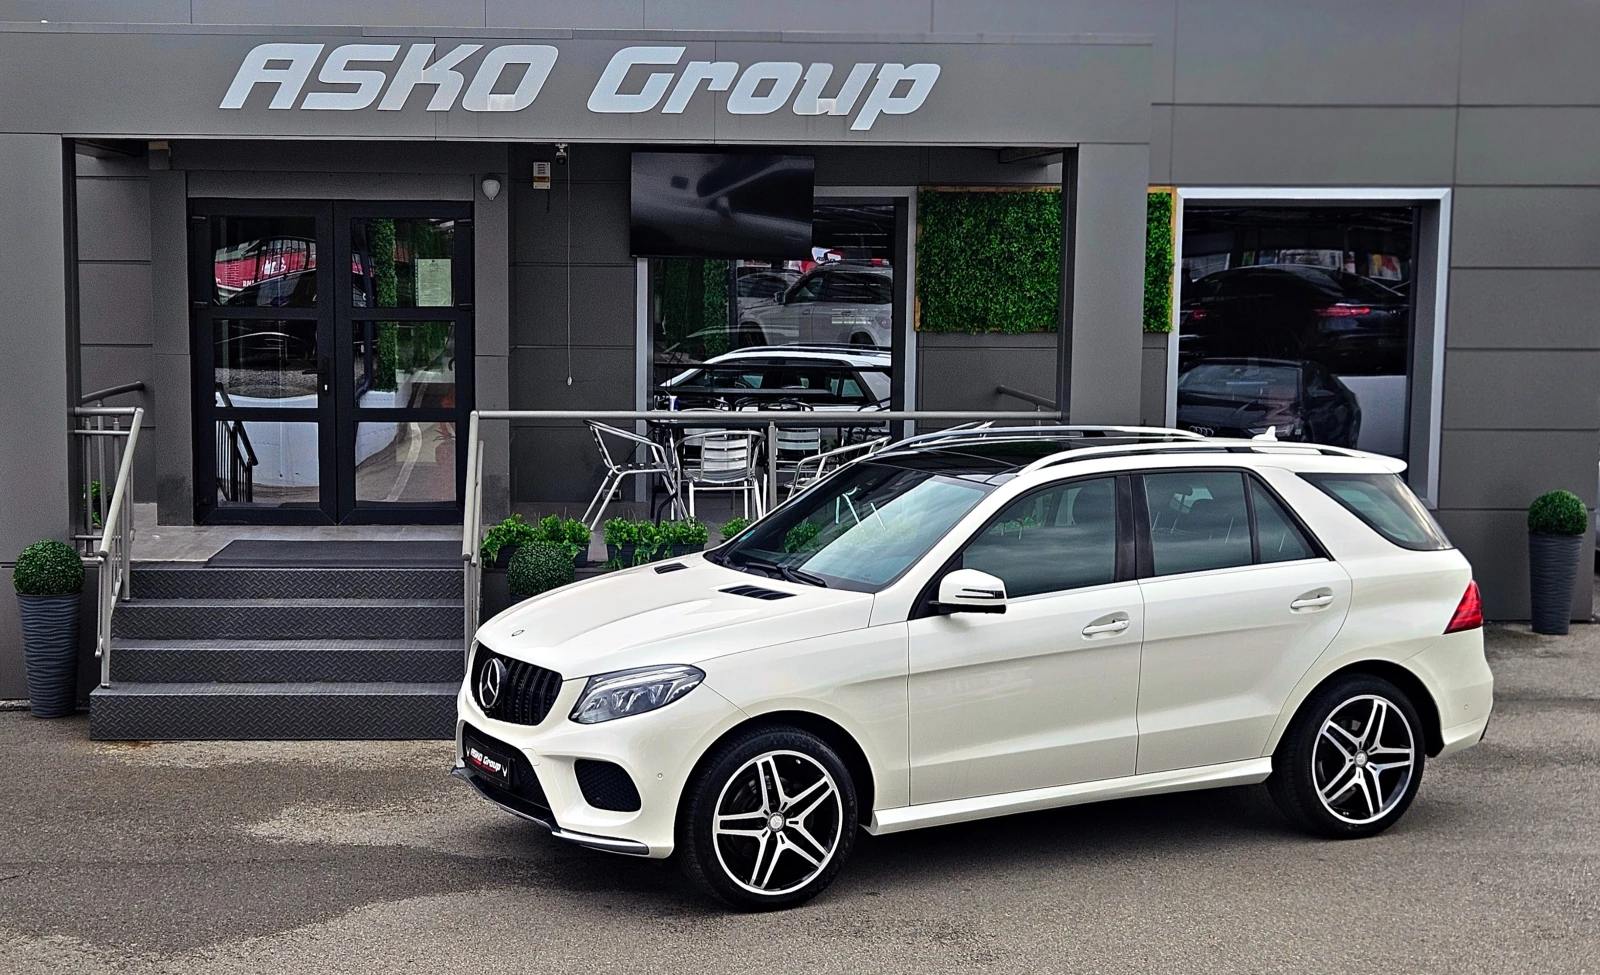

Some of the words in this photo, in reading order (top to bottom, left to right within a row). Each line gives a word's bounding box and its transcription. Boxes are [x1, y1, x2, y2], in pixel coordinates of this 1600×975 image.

[219, 43, 558, 112] ASKO
[586, 45, 941, 131] Group
[483, 756, 502, 772] Group
